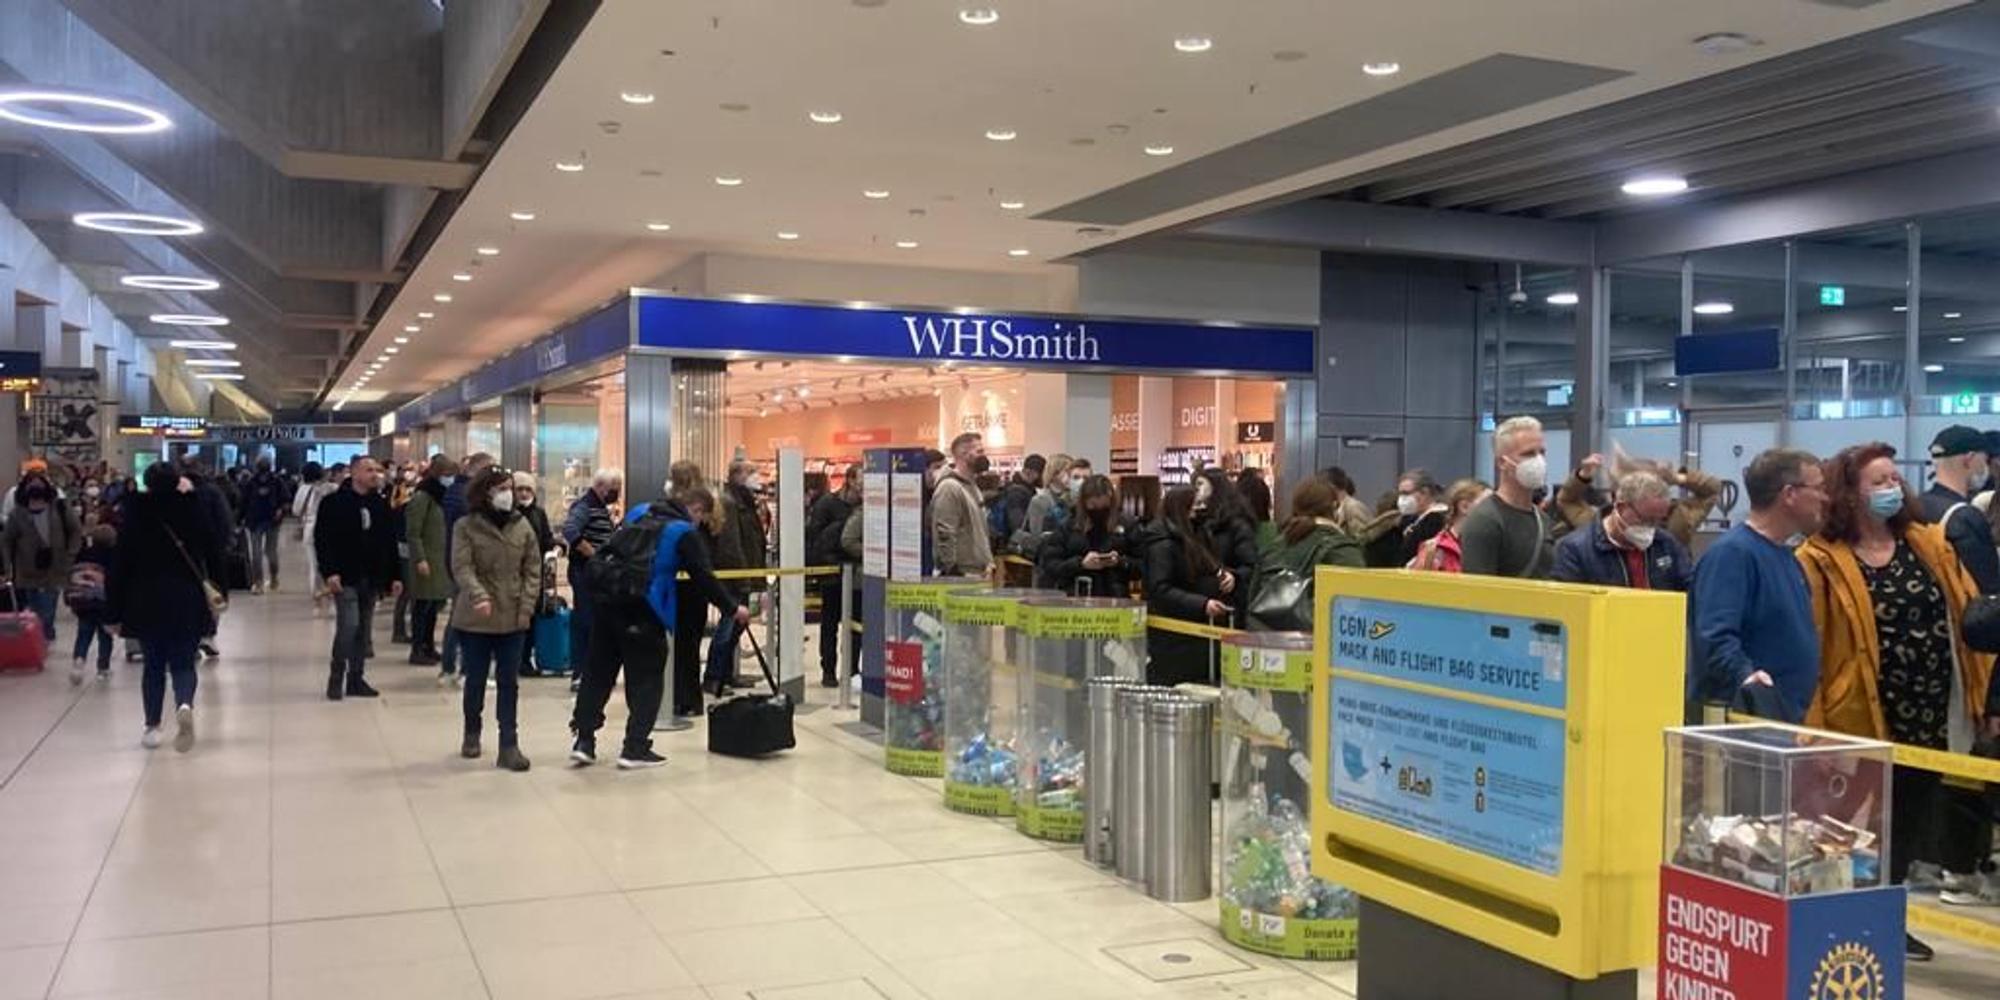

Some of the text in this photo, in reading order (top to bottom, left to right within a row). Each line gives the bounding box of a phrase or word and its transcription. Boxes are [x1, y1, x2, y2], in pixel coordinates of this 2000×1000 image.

[903, 316, 1100, 360] WHSmith
[1181, 406, 1216, 428] DIGIT
[1339, 615, 1366, 638] CGN
[1339, 641, 1368, 660] MASK
[1373, 646, 1396, 667] AND
[1400, 652, 1443, 673] FLIGHT
[1449, 658, 1474, 681] BAG
[1480, 663, 1540, 691] SERVICE
[1667, 894, 1772, 957] ENDSPURT
[1666, 933, 1729, 983] GEGEN
